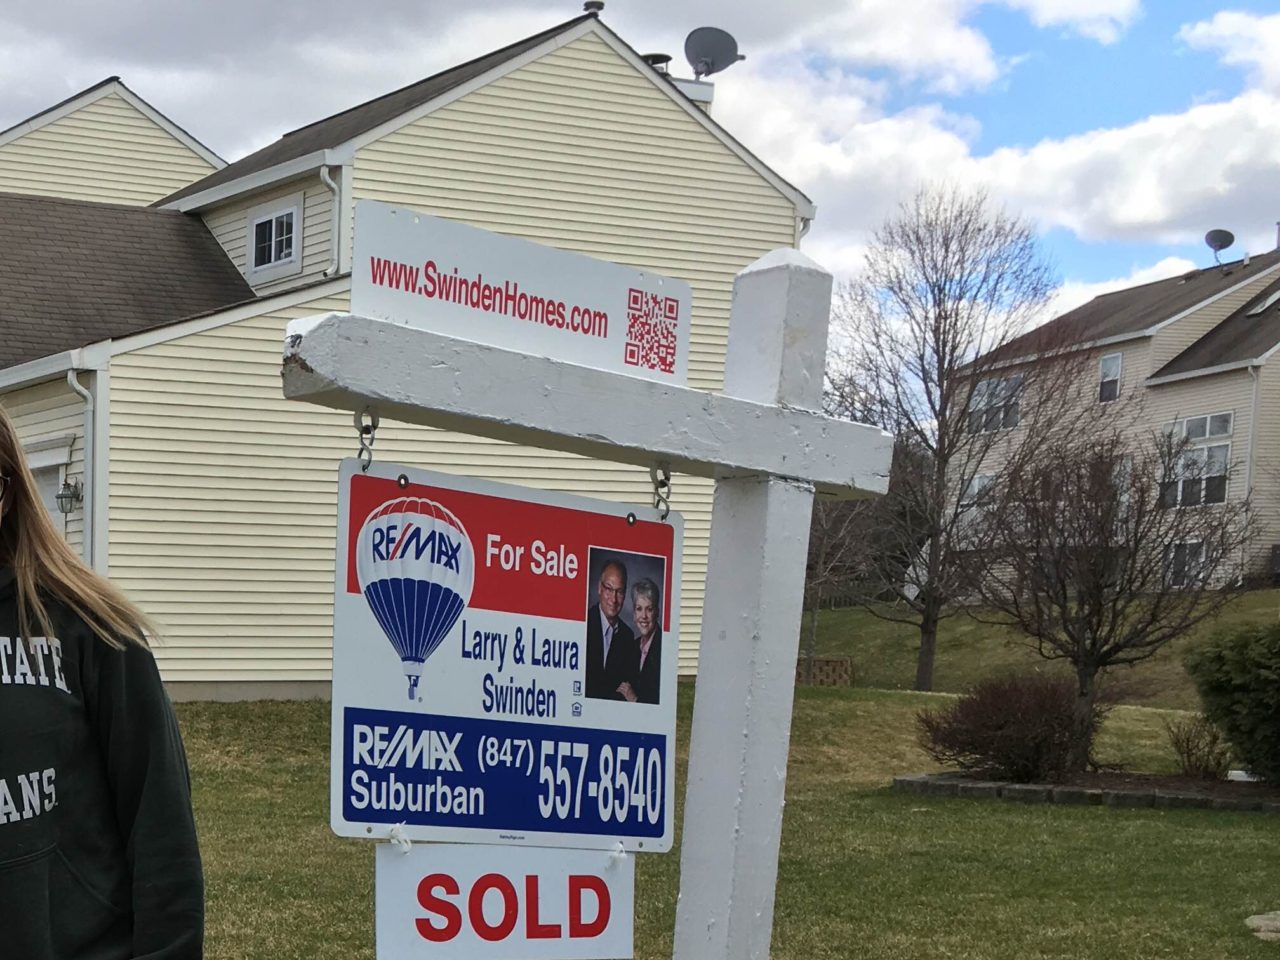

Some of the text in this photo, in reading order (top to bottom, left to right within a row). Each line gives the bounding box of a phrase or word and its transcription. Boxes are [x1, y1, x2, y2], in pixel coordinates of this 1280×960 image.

[370, 256, 608, 339] www.SwindenHomes.com
[372, 522, 461, 574] RE/MAX
[485, 533, 579, 579] For Sale
[461, 620, 580, 673] Larry & Laura
[482, 673, 557, 718] Swinden
[352, 724, 464, 772] RE/MAX
[350, 769, 485, 815] Suburban
[477, 735, 662, 825] (847) 557-8540
[414, 872, 612, 943] SOLD
